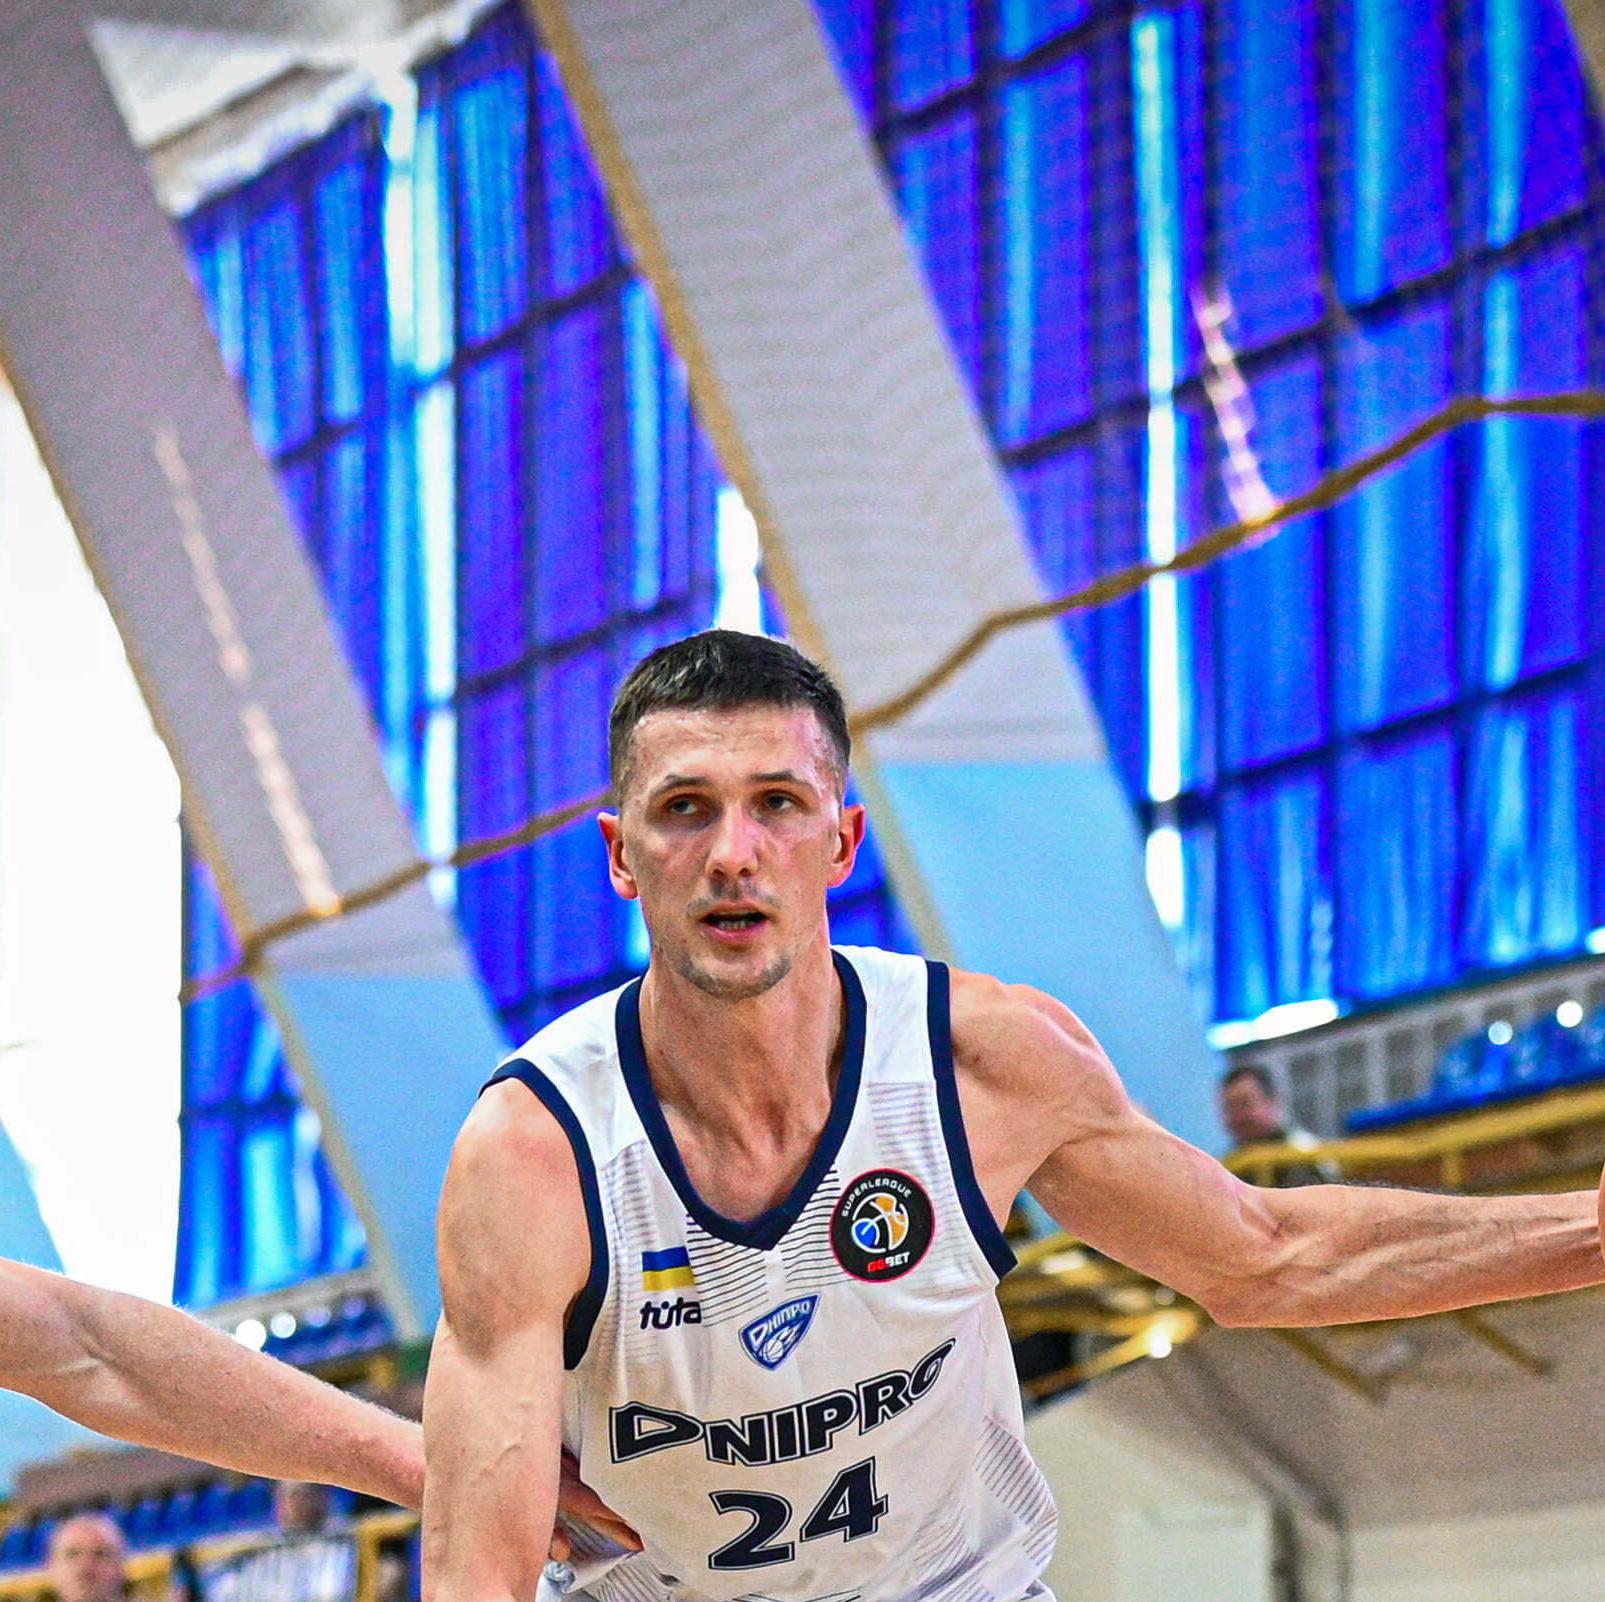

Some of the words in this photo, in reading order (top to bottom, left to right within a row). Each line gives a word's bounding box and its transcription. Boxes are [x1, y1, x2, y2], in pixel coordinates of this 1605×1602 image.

[841, 1178, 912, 1217] SUPERLEAGUE
[609, 1337, 957, 1467] DNIPRO
[707, 1456, 890, 1571] 24
